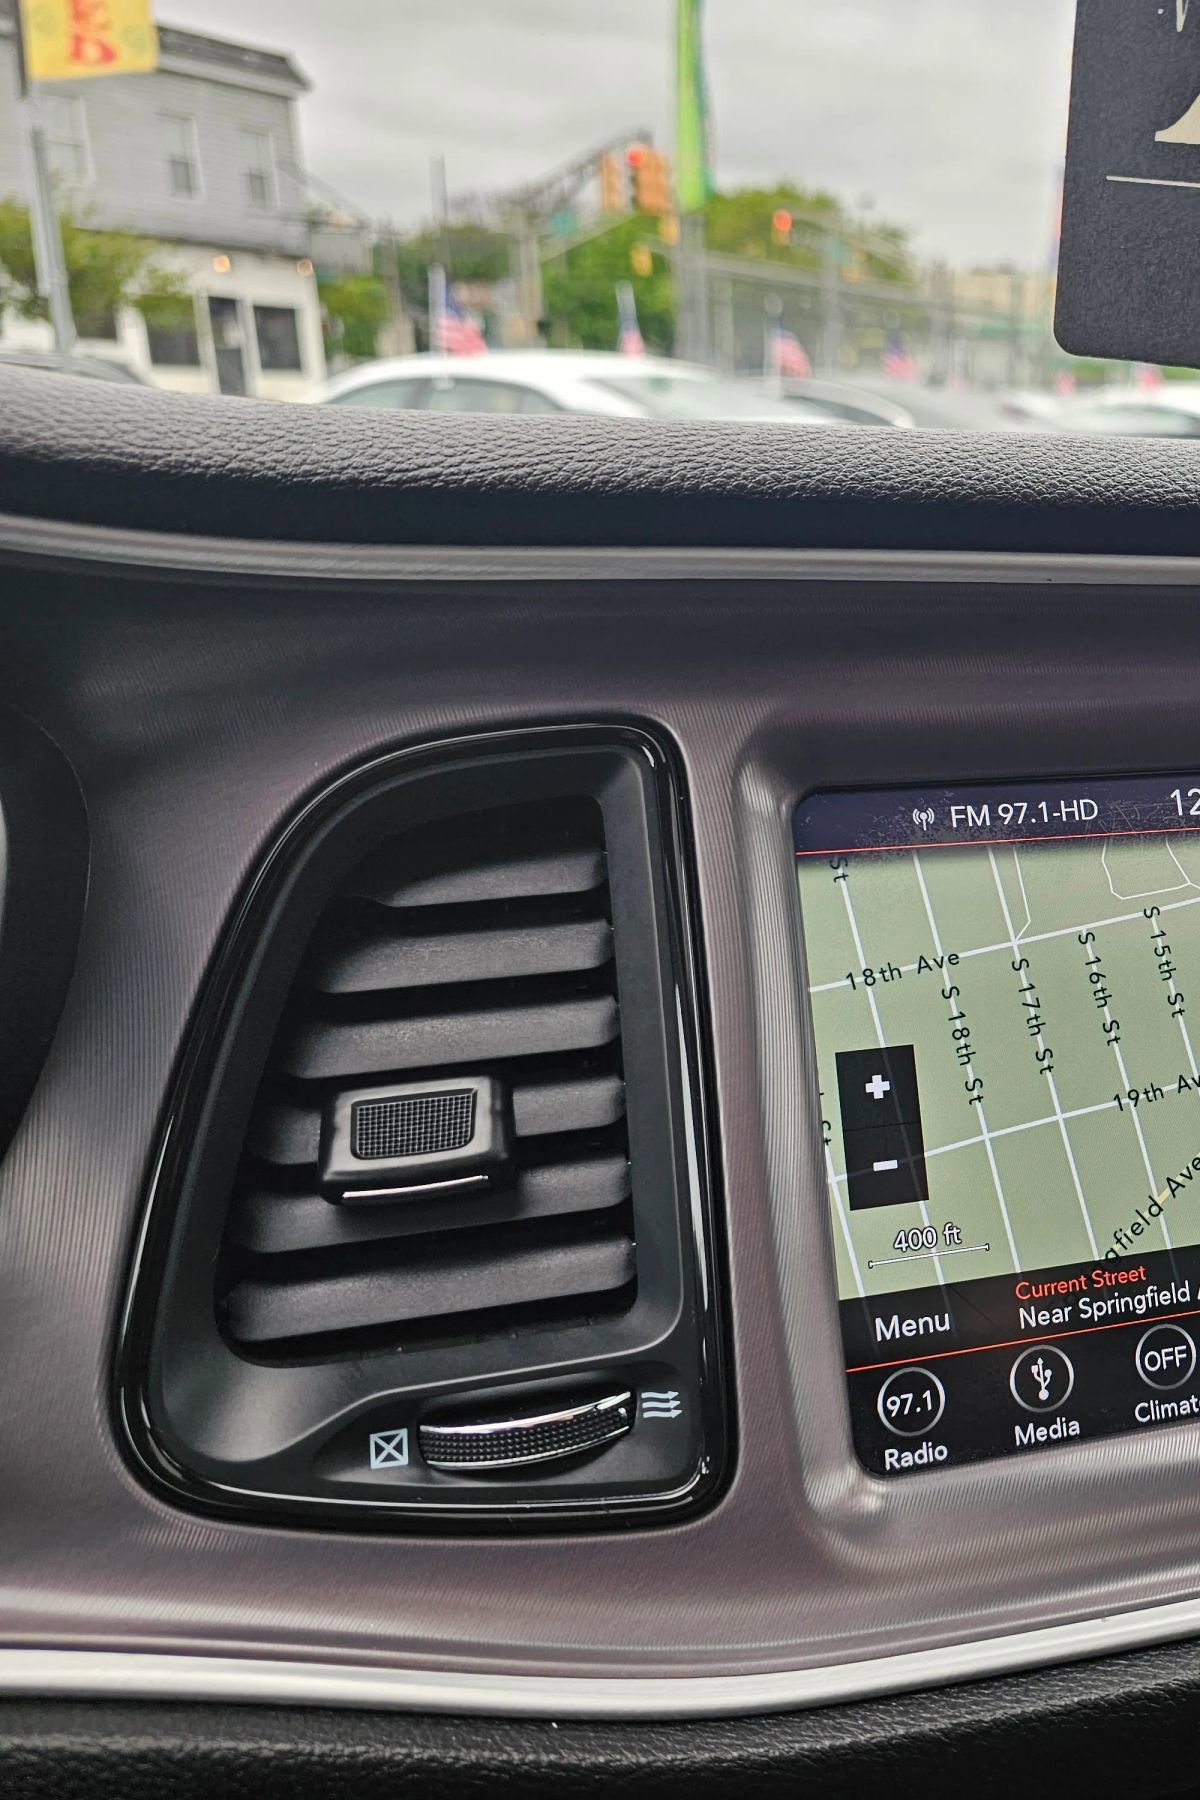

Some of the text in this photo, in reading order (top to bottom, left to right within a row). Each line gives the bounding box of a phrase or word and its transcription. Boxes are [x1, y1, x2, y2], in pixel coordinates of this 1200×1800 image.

[950, 799, 1099, 828] FM 97.1-HD
[830, 856, 849, 883] St
[846, 950, 960, 991] 18th Ave
[1143, 906, 1186, 1019] S 15th St
[1078, 931, 1121, 1046] S 16th St
[1011, 957, 1054, 1075] S 17th St
[941, 985, 984, 1105] S 18th St
[1112, 1086, 1164, 1112] 19th
[893, 1222, 963, 1253] 400 ft
[1015, 1264, 1147, 1301] Current Street
[1018, 1304, 1073, 1330] Near
[1078, 1279, 1191, 1322] Springfield
[874, 1312, 951, 1343] Menu
[1144, 1344, 1188, 1373] OFF
[885, 1391, 934, 1418] 97.1
[1014, 1417, 1081, 1447] Media
[883, 1442, 949, 1471] Radio
